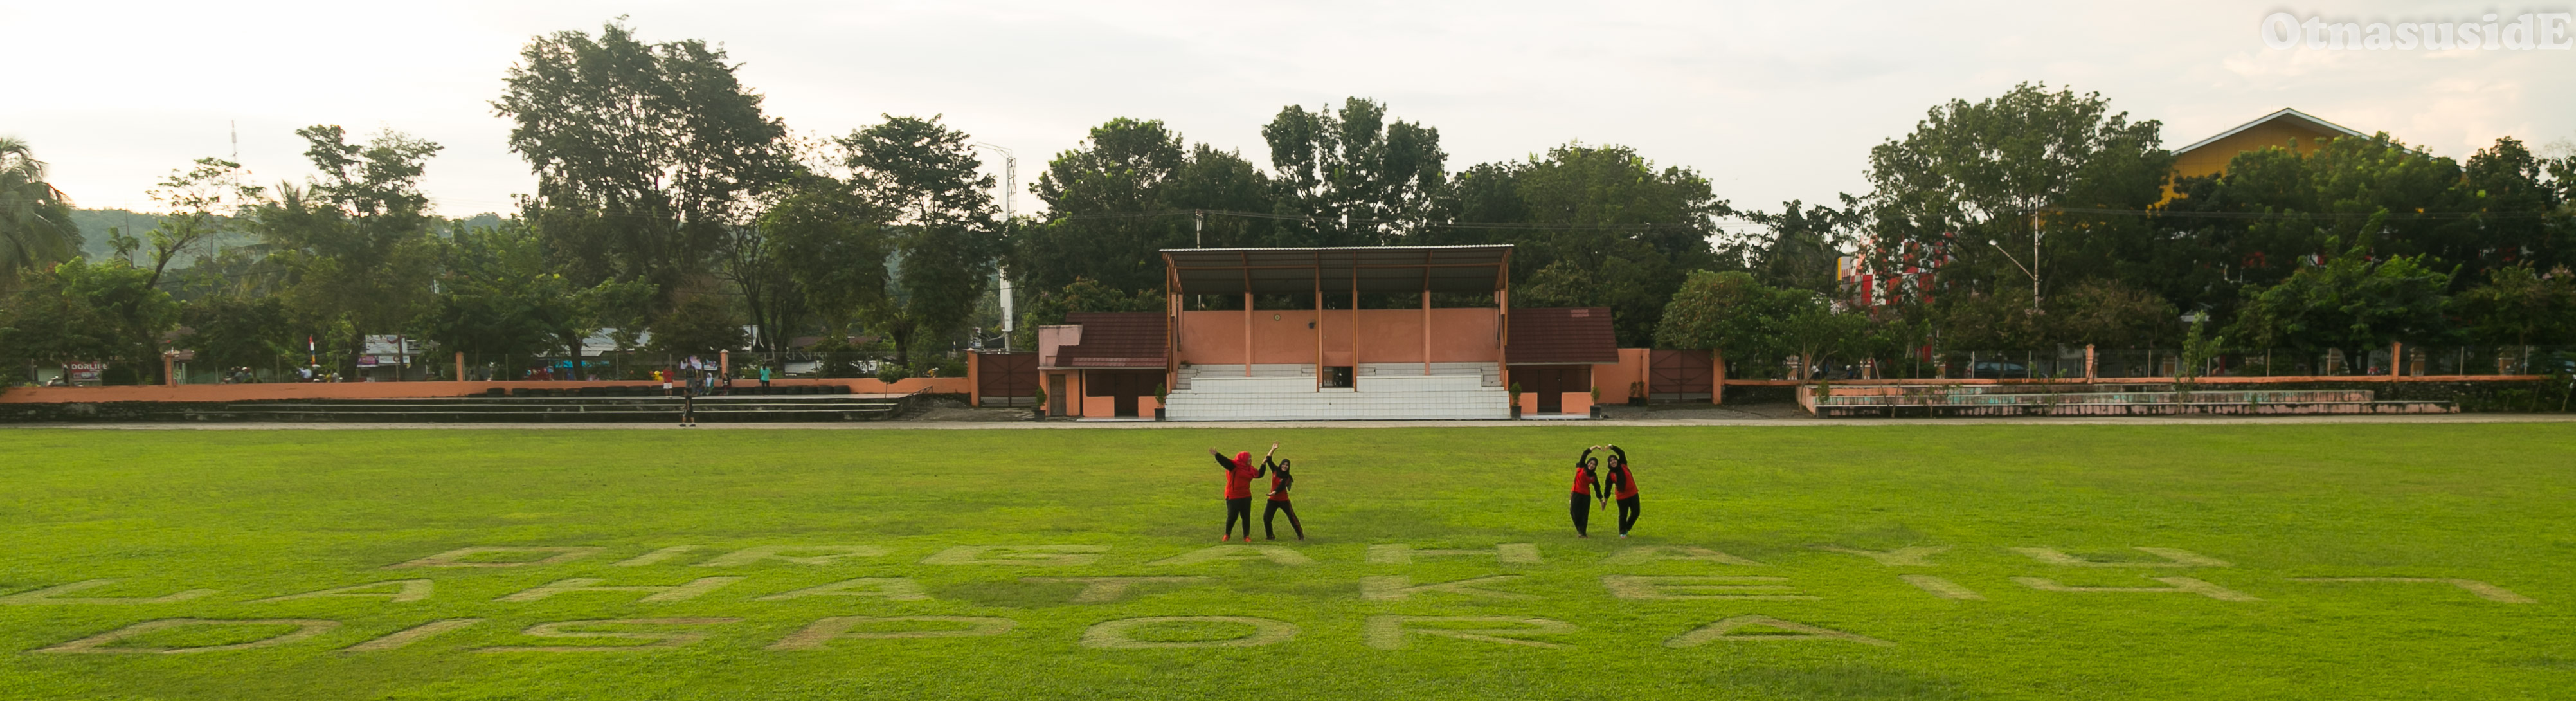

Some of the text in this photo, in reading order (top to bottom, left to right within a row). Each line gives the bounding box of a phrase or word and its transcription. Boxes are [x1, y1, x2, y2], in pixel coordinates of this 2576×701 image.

[0, 574, 2538, 605] LAHAT KE 147
[31, 614, 1898, 653] DISPORA
